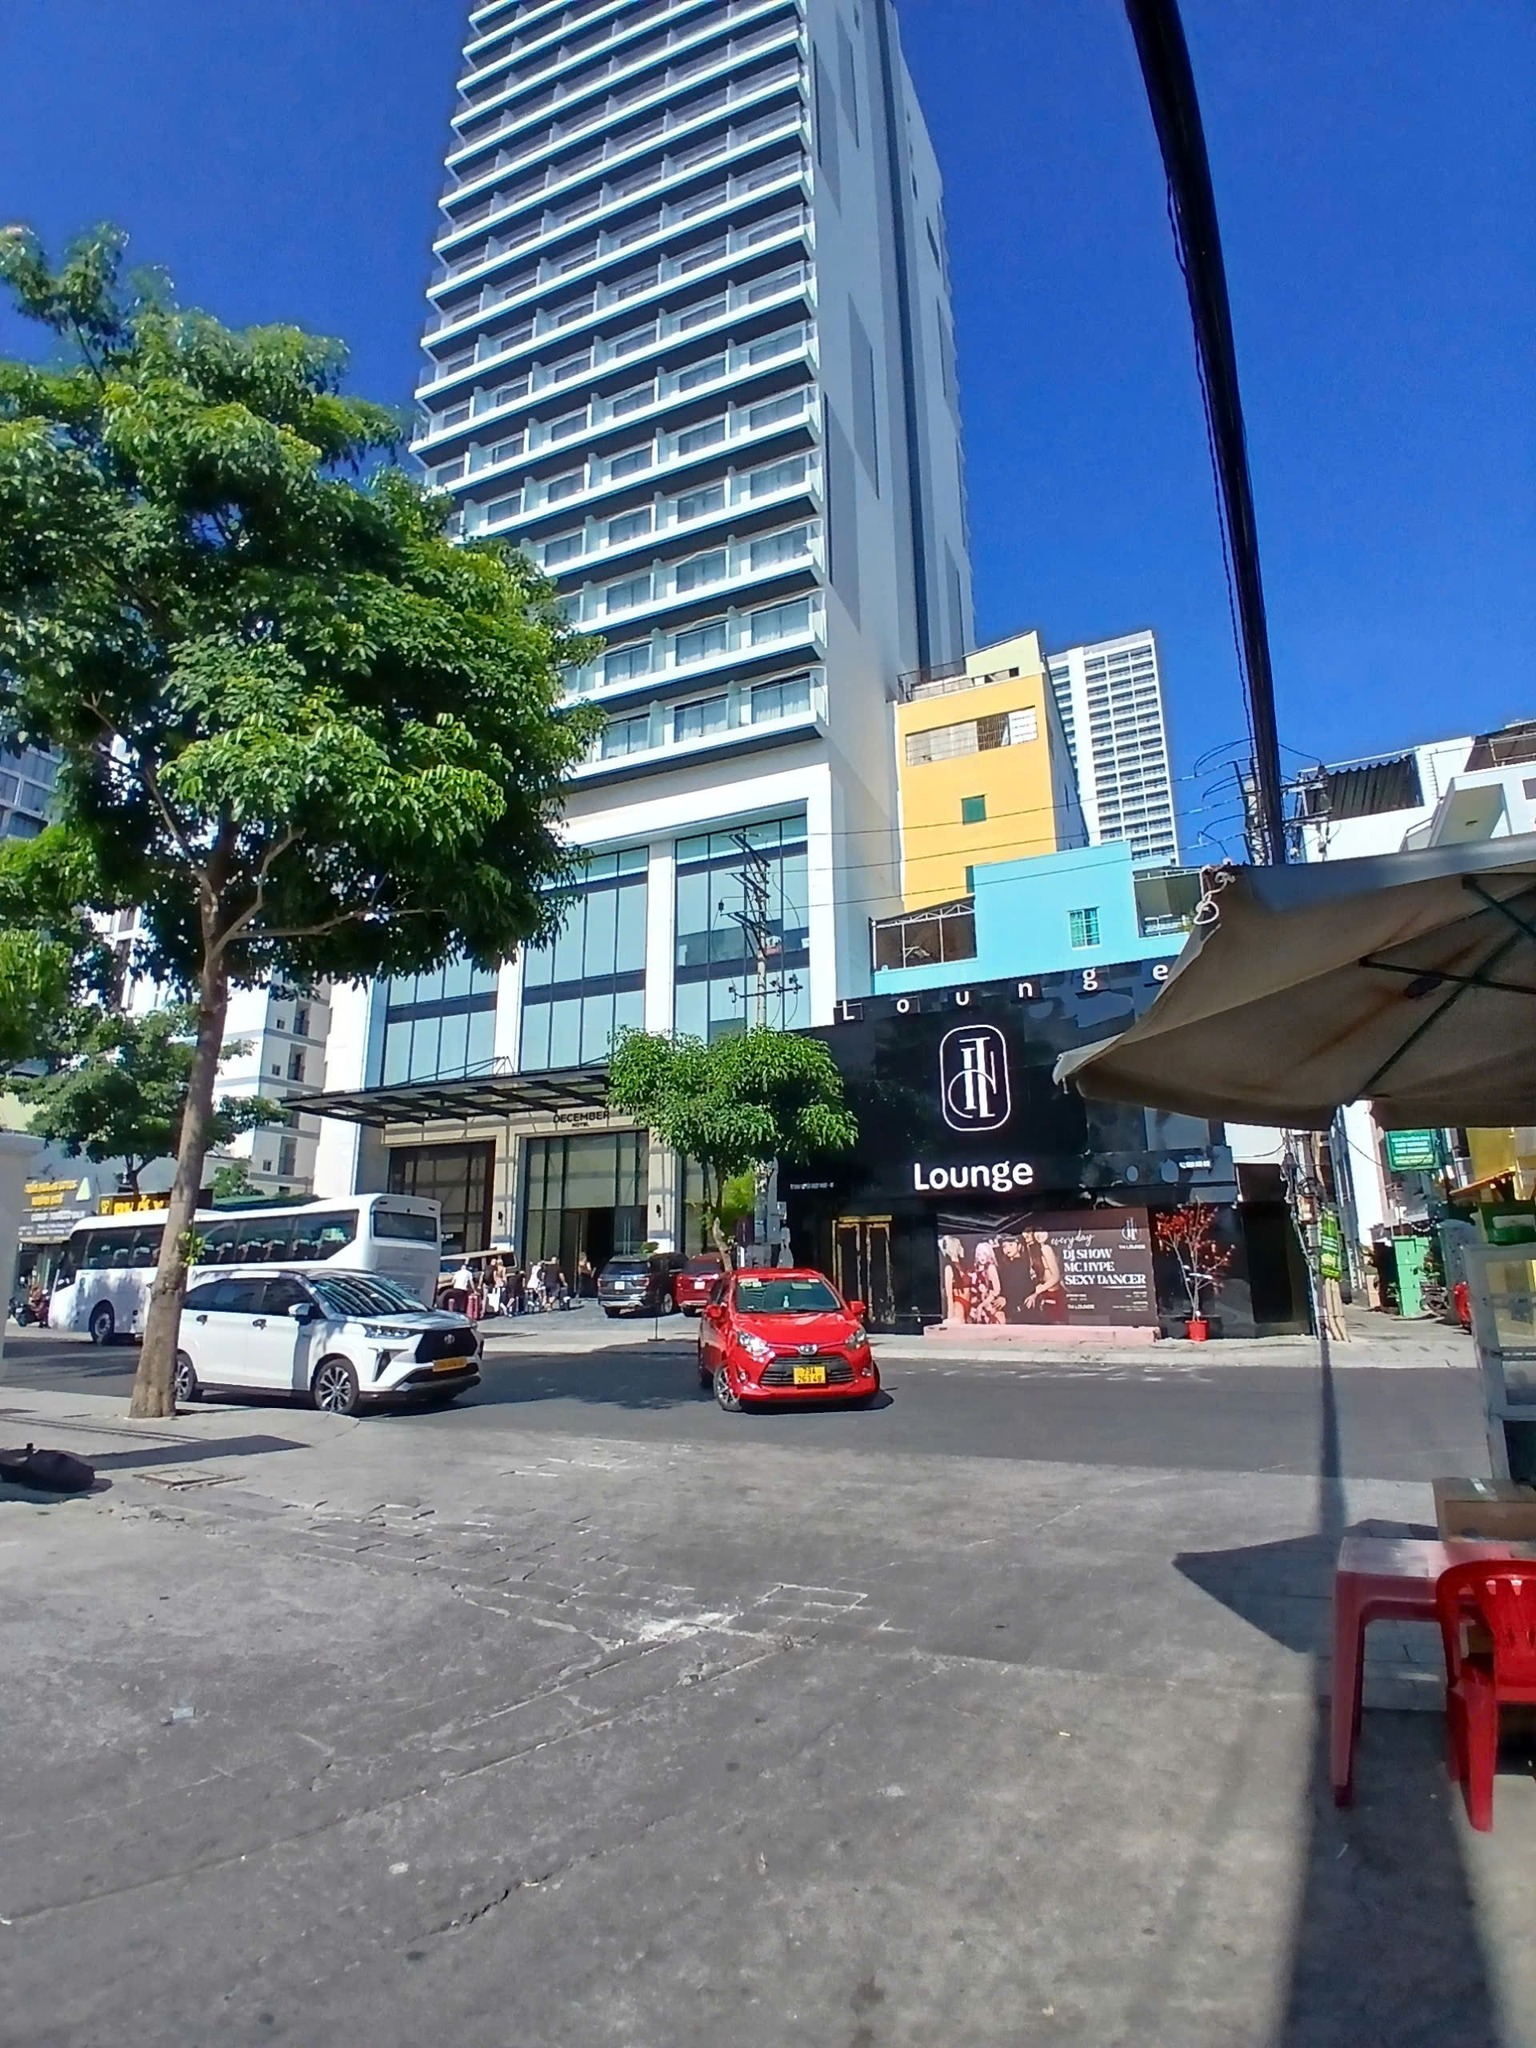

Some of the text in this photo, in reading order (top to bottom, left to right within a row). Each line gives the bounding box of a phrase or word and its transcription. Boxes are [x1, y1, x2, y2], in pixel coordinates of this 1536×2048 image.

[553, 1111, 609, 1123] DECEMBER
[914, 1160, 1034, 1193] Lounge
[1050, 1227, 1095, 1249] everyday
[1062, 1248, 1113, 1261] DJ SHOW
[1063, 1261, 1116, 1273] MC HYPE
[1064, 1274, 1147, 1286] SEXY DANCER
